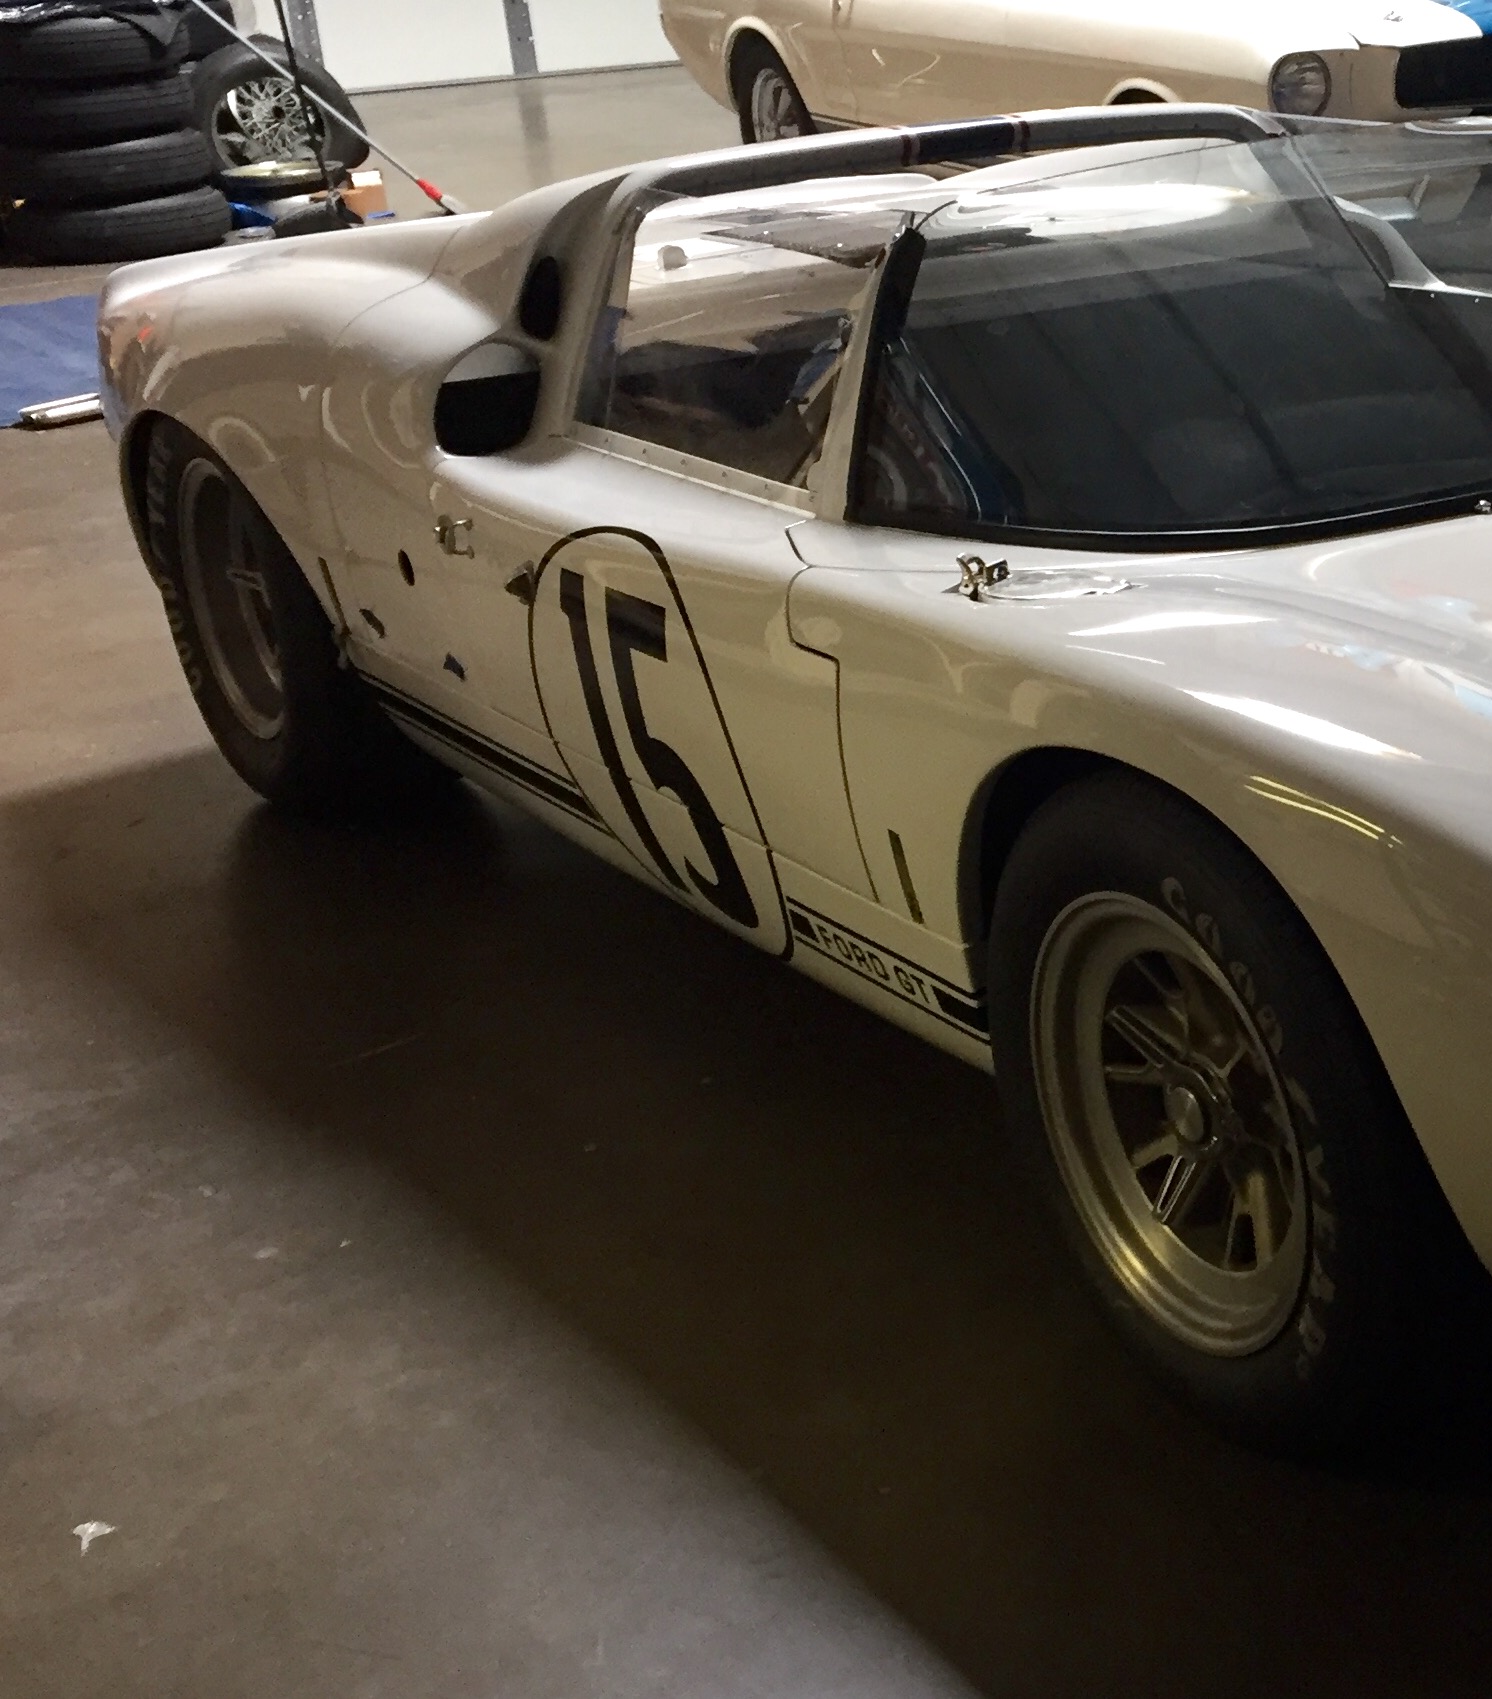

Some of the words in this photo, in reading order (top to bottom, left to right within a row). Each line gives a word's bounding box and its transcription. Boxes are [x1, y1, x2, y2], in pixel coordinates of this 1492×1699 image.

[560, 567, 759, 928] 15
[816, 924, 890, 981] FORD
[893, 964, 931, 1004] GT
